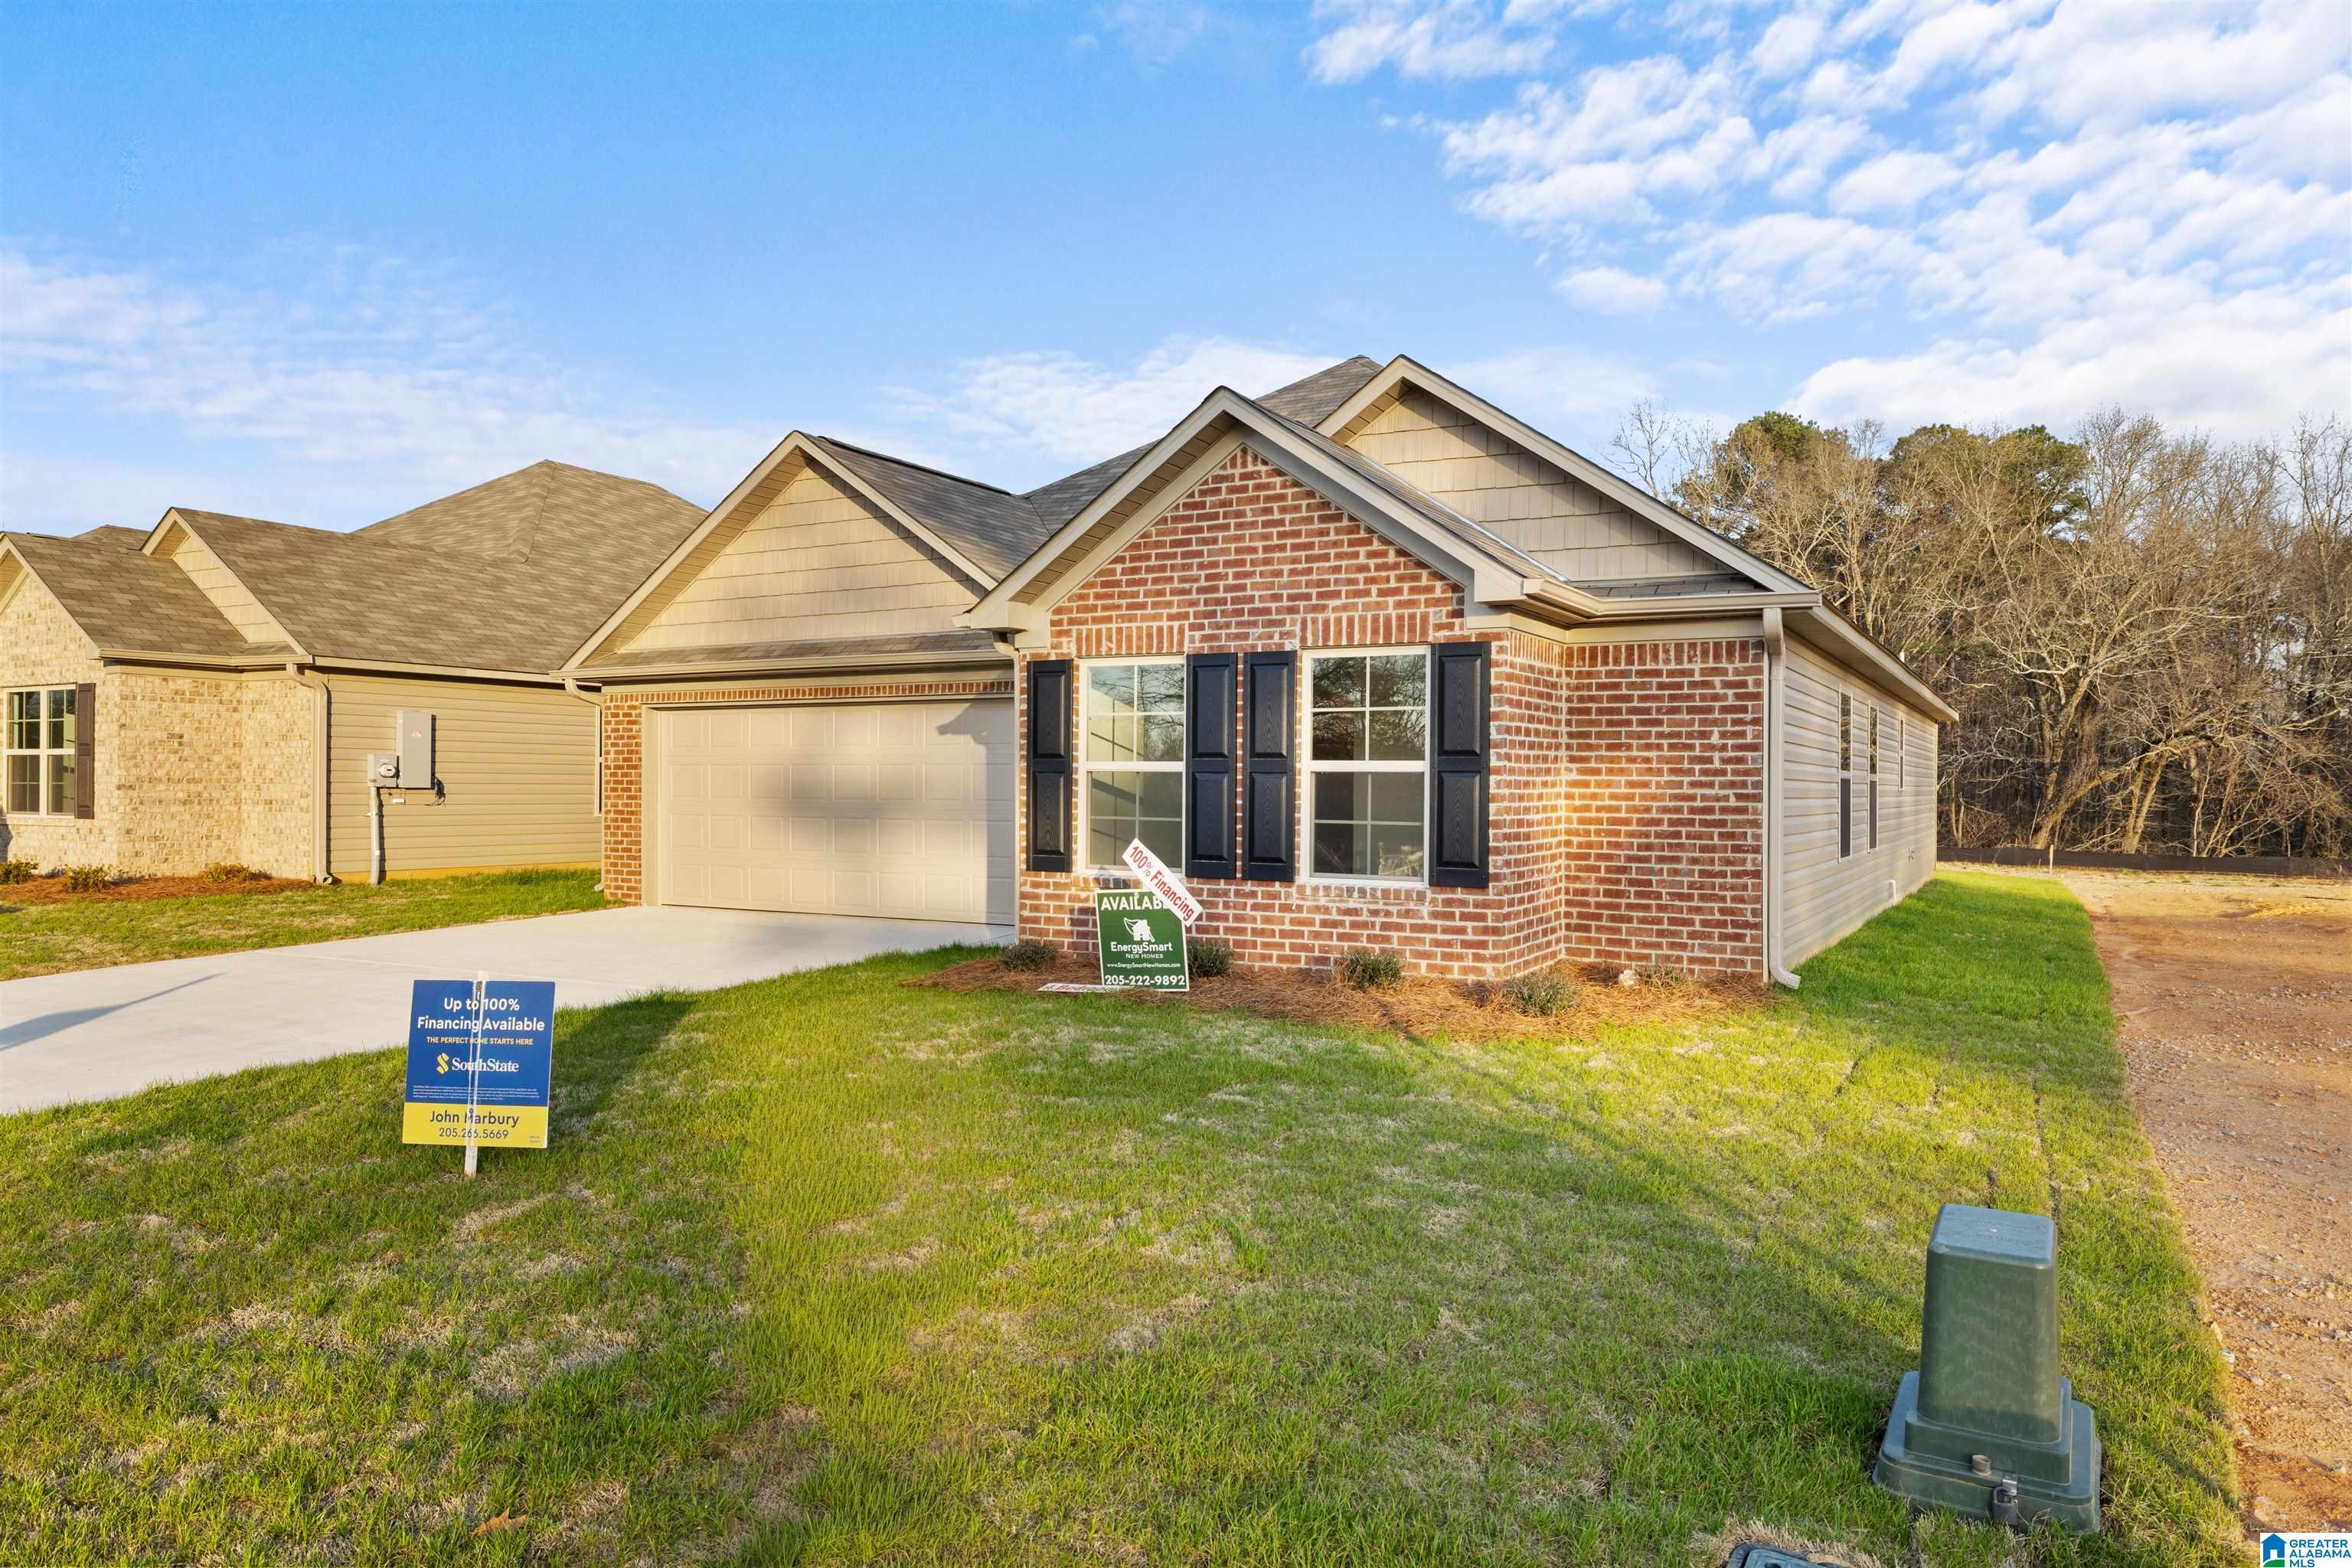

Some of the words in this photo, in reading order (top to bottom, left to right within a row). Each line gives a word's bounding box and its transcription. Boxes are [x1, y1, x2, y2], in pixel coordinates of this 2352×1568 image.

[1130, 846, 1155, 877] 100%
[1150, 870, 1194, 921] Financing
[1101, 895, 1170, 910] AVAILAB
[1110, 942, 1173, 953] EnergySmart
[1105, 975, 1186, 985] 205-222-9892
[444, 998, 462, 1012] Up
[466, 998, 479, 1010] to
[483, 998, 520, 1011] 100%
[417, 1015, 479, 1033] Financing
[482, 1017, 545, 1031] Available
[452, 1057, 519, 1072] SouthState
[430, 1109, 459, 1122] John
